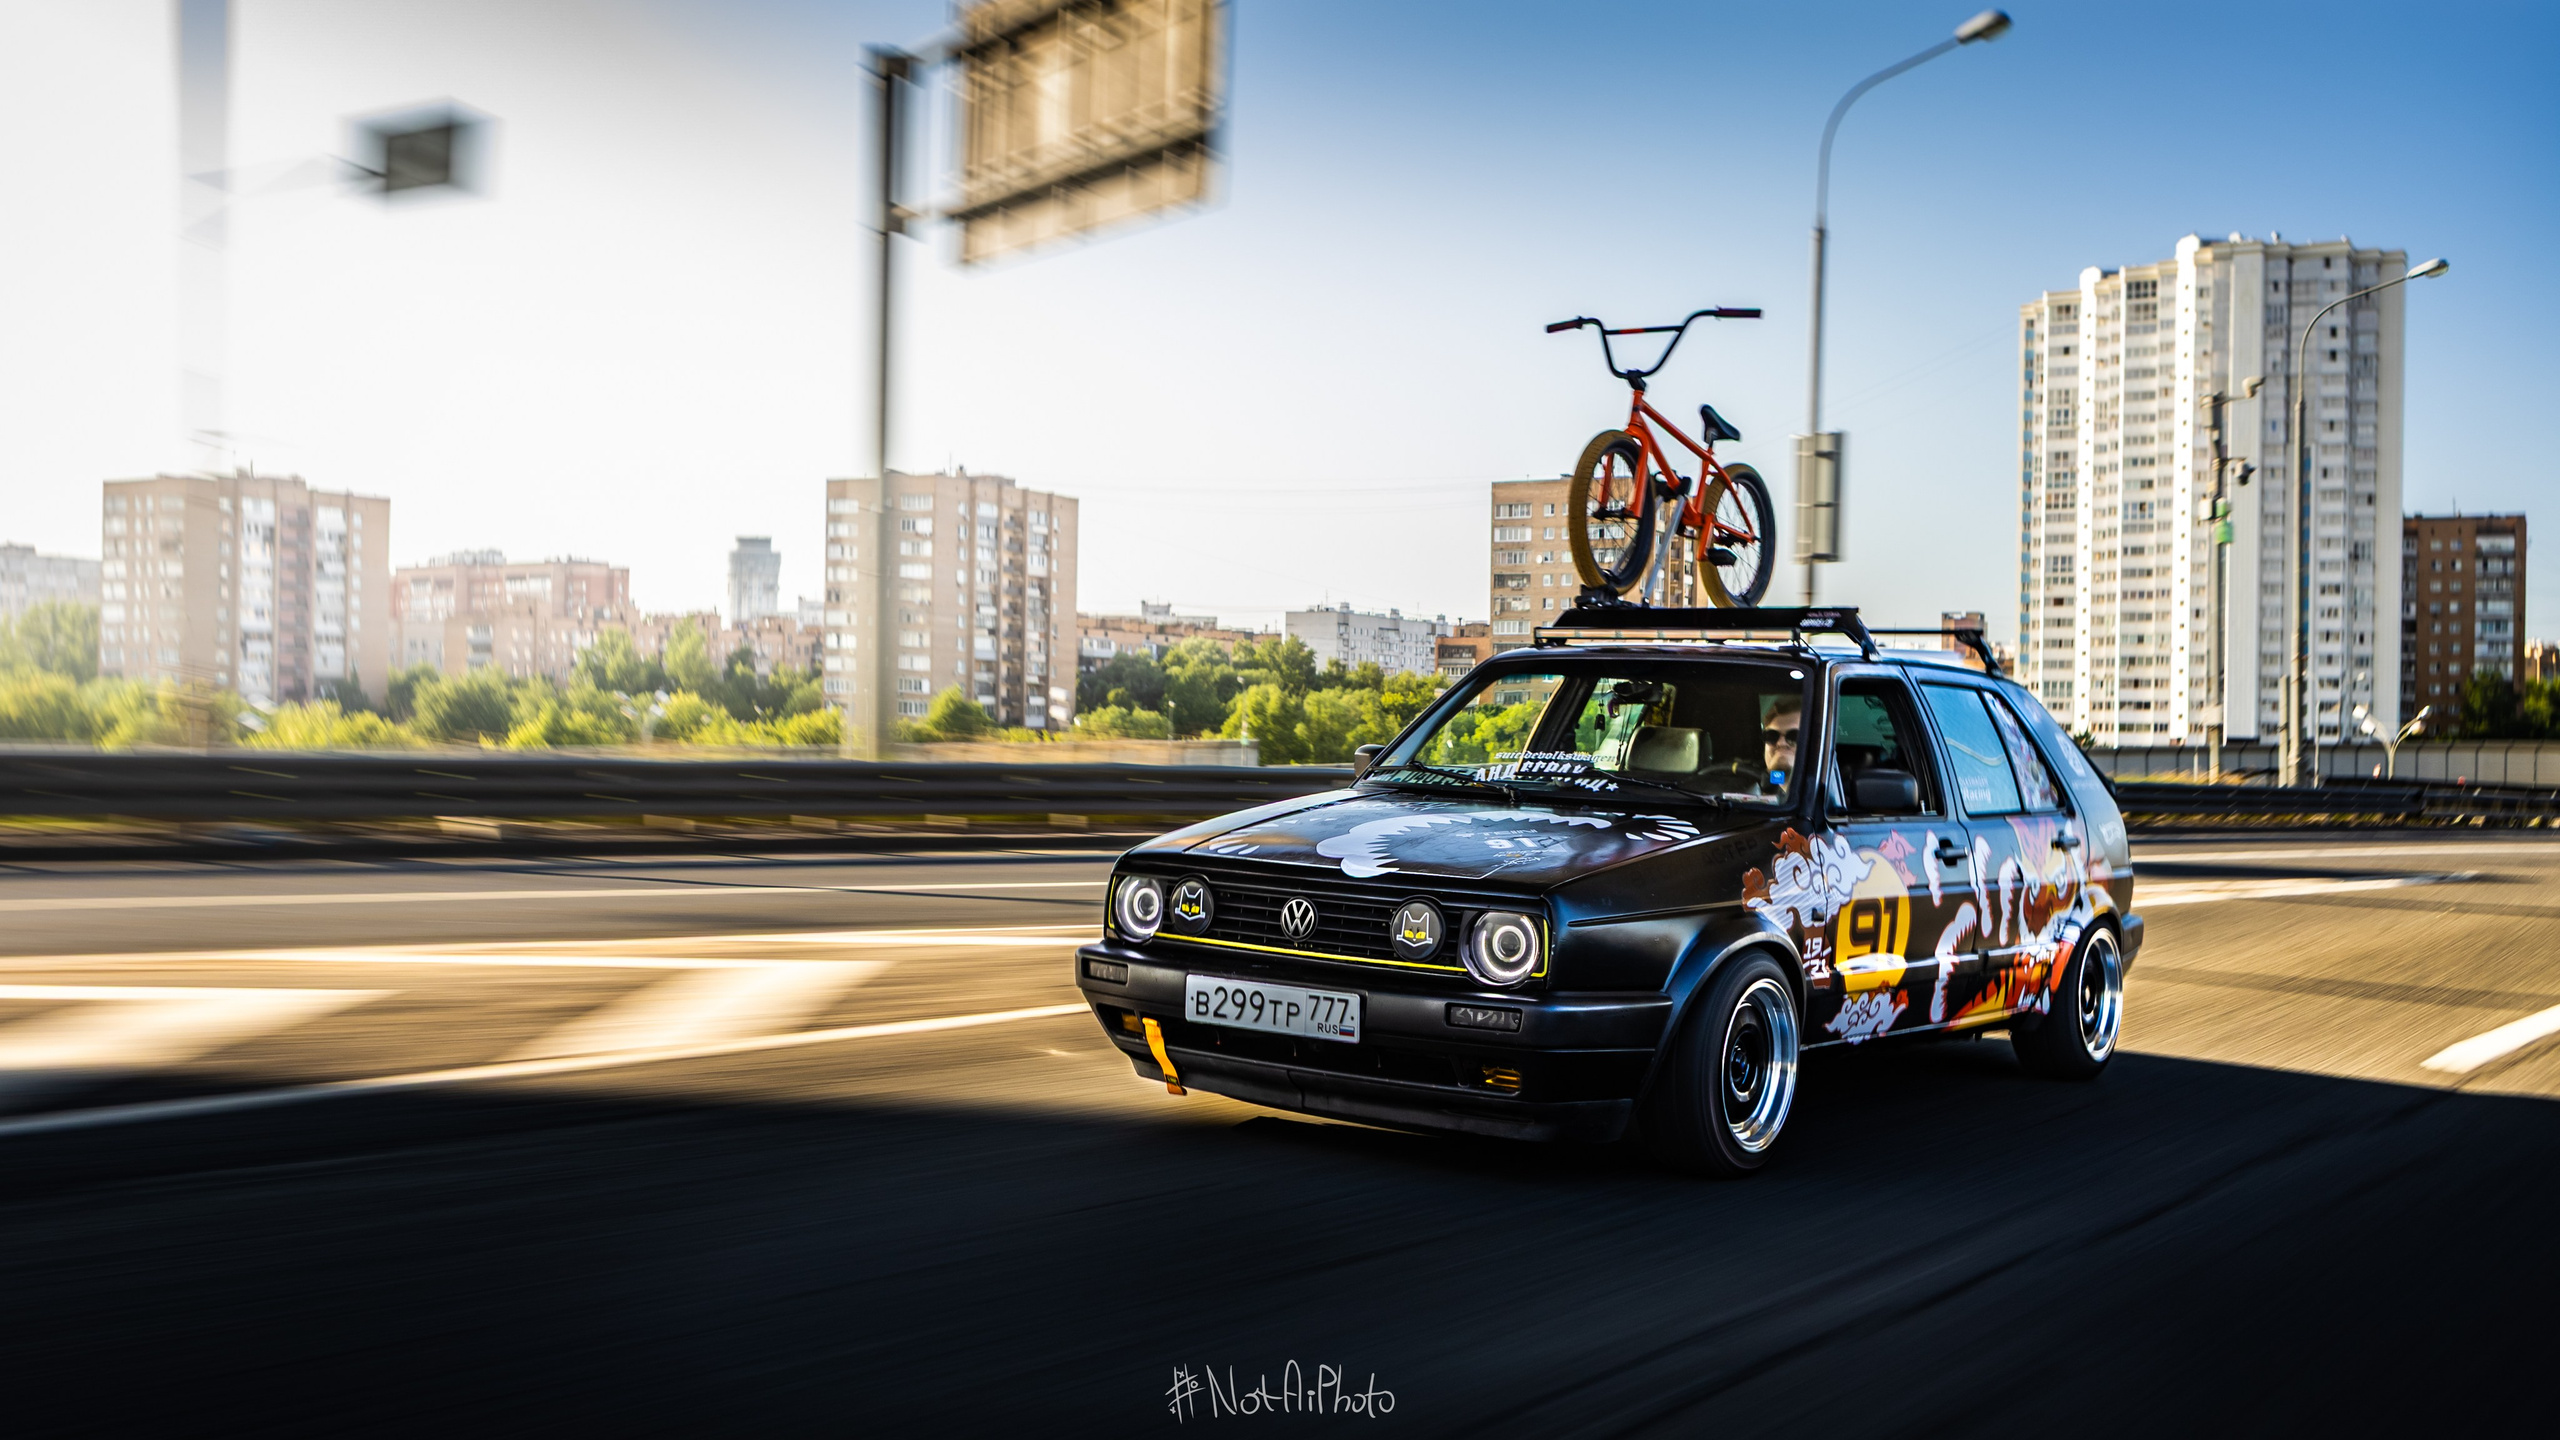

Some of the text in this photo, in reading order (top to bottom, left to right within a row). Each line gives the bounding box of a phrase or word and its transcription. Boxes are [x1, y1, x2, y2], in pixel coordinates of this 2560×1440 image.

[1484, 838, 1539, 849] 91
[1847, 895, 1900, 960] 91
[1308, 994, 1350, 1024] 777
[1317, 1022, 1339, 1035] RUS
